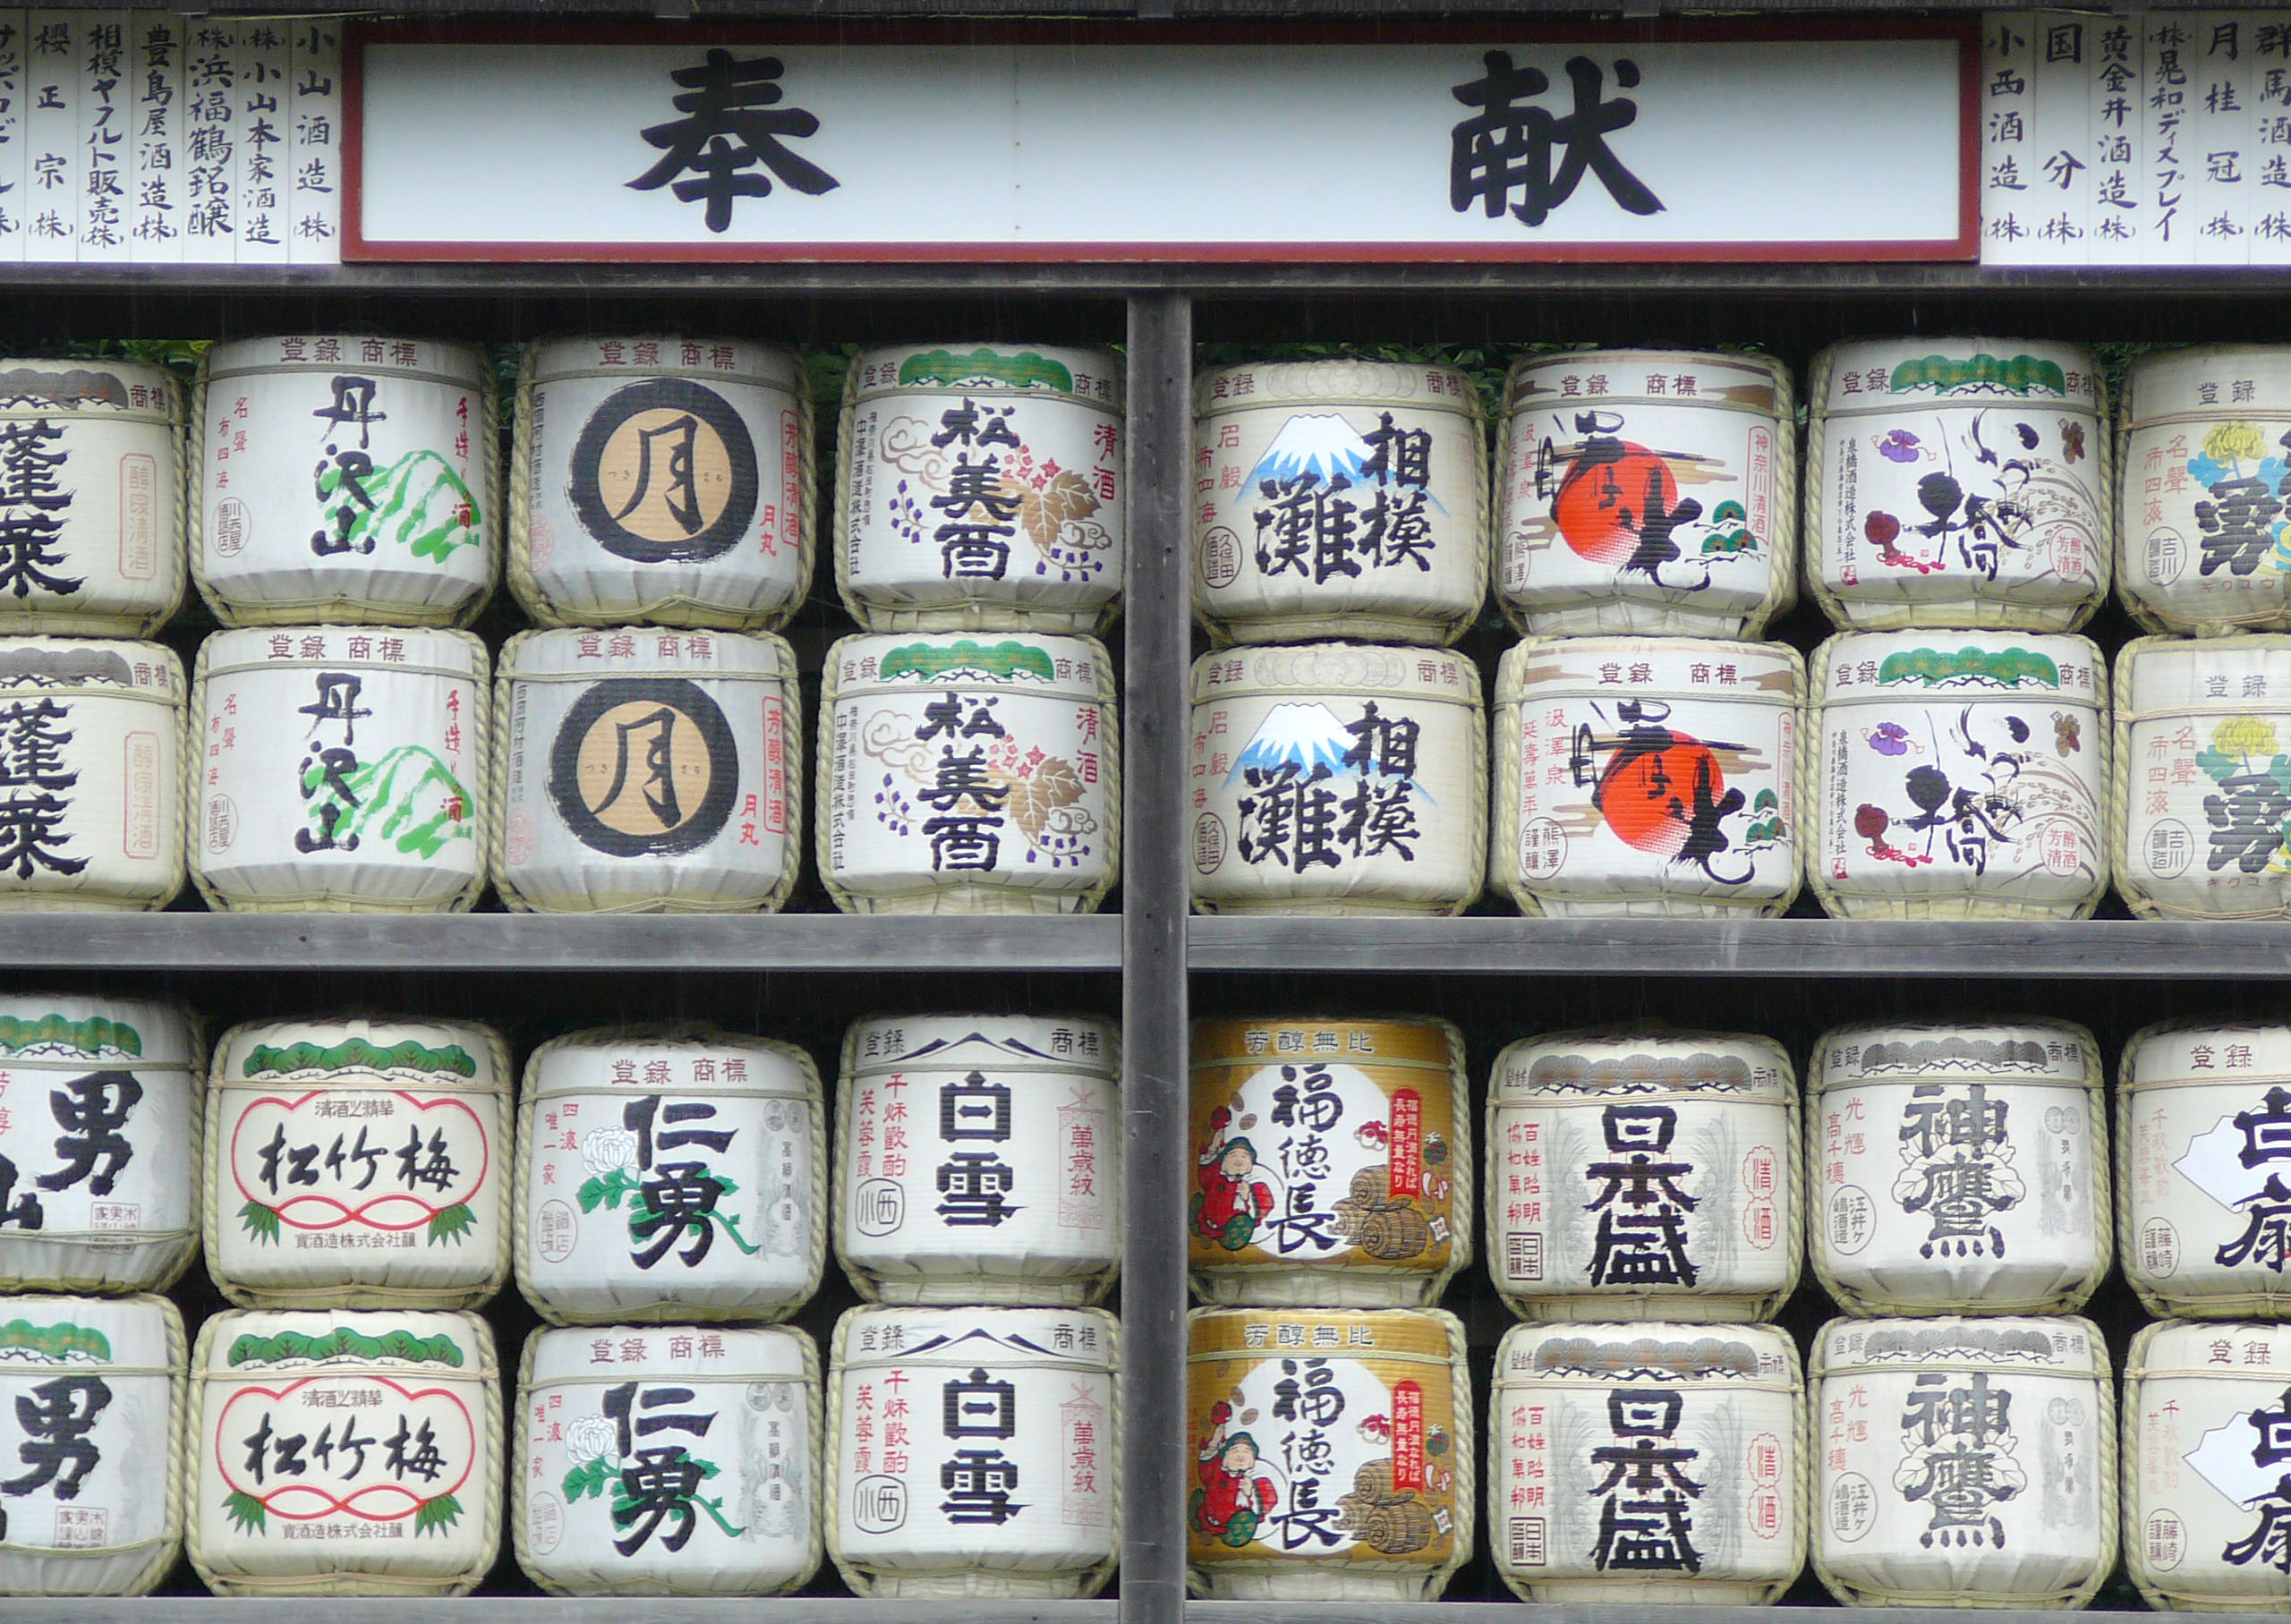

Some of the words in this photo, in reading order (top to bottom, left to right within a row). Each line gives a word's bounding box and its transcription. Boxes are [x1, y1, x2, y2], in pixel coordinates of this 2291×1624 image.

[2198, 379, 2255, 405] 登録
[2206, 675, 2267, 698] 登録
[2191, 1044, 2253, 1069] 登録
[257, 1121, 460, 1195] 松竹梅
[934, 1070, 1029, 1227] 白雪
[2208, 1339, 2271, 1365] 登録
[243, 1411, 447, 1485] 松竹梅
[938, 1367, 1035, 1526] 白雪
